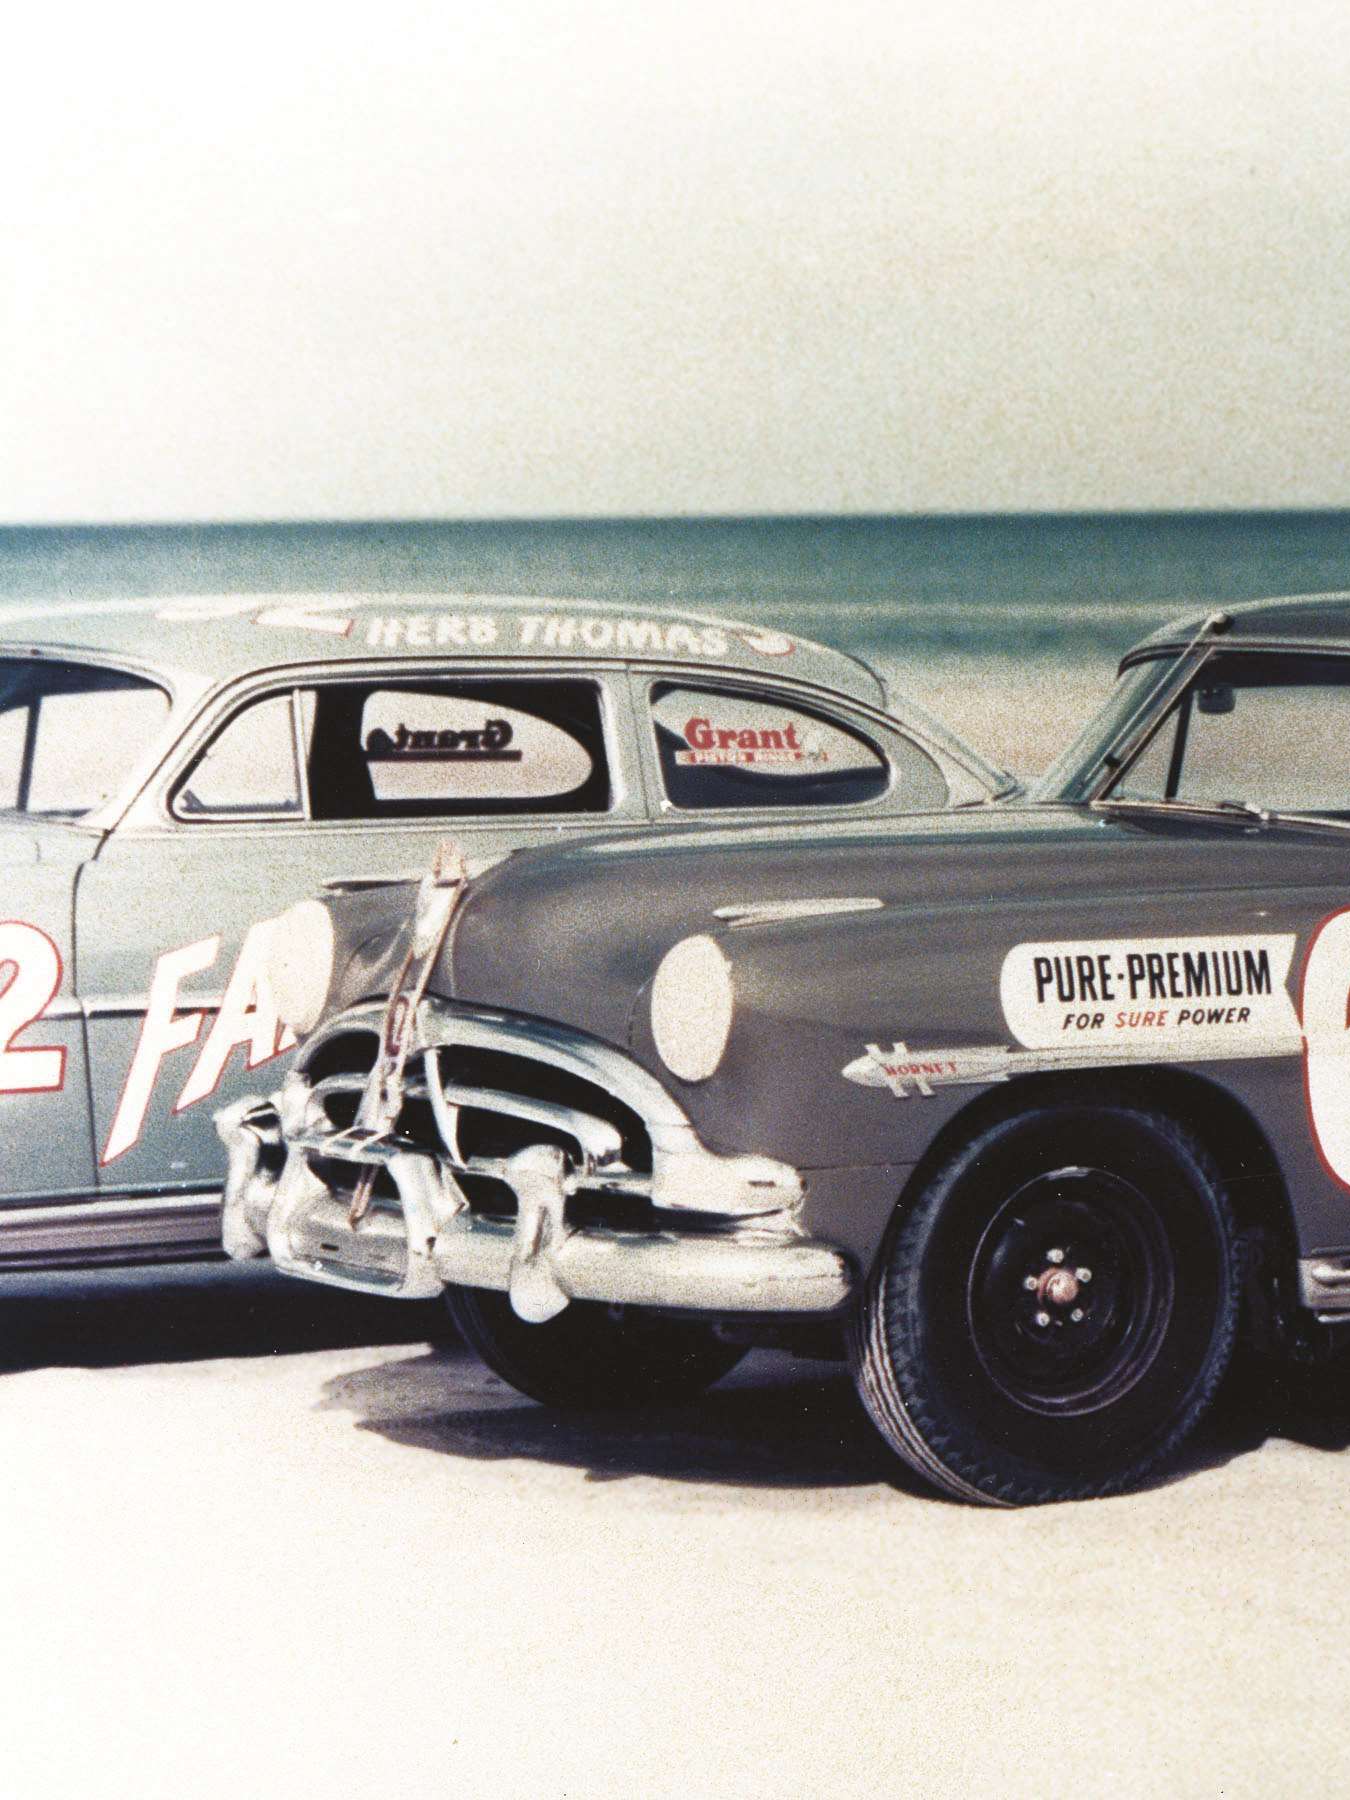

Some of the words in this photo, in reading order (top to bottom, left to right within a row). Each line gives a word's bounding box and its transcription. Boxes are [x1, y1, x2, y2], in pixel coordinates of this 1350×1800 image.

[366, 615, 498, 648] HERB
[518, 615, 728, 657] THOMAS
[683, 716, 801, 750] Grant
[1062, 1012, 1106, 1031] FOR
[1115, 1010, 1168, 1029] SURE
[1177, 1006, 1251, 1027] POWER
